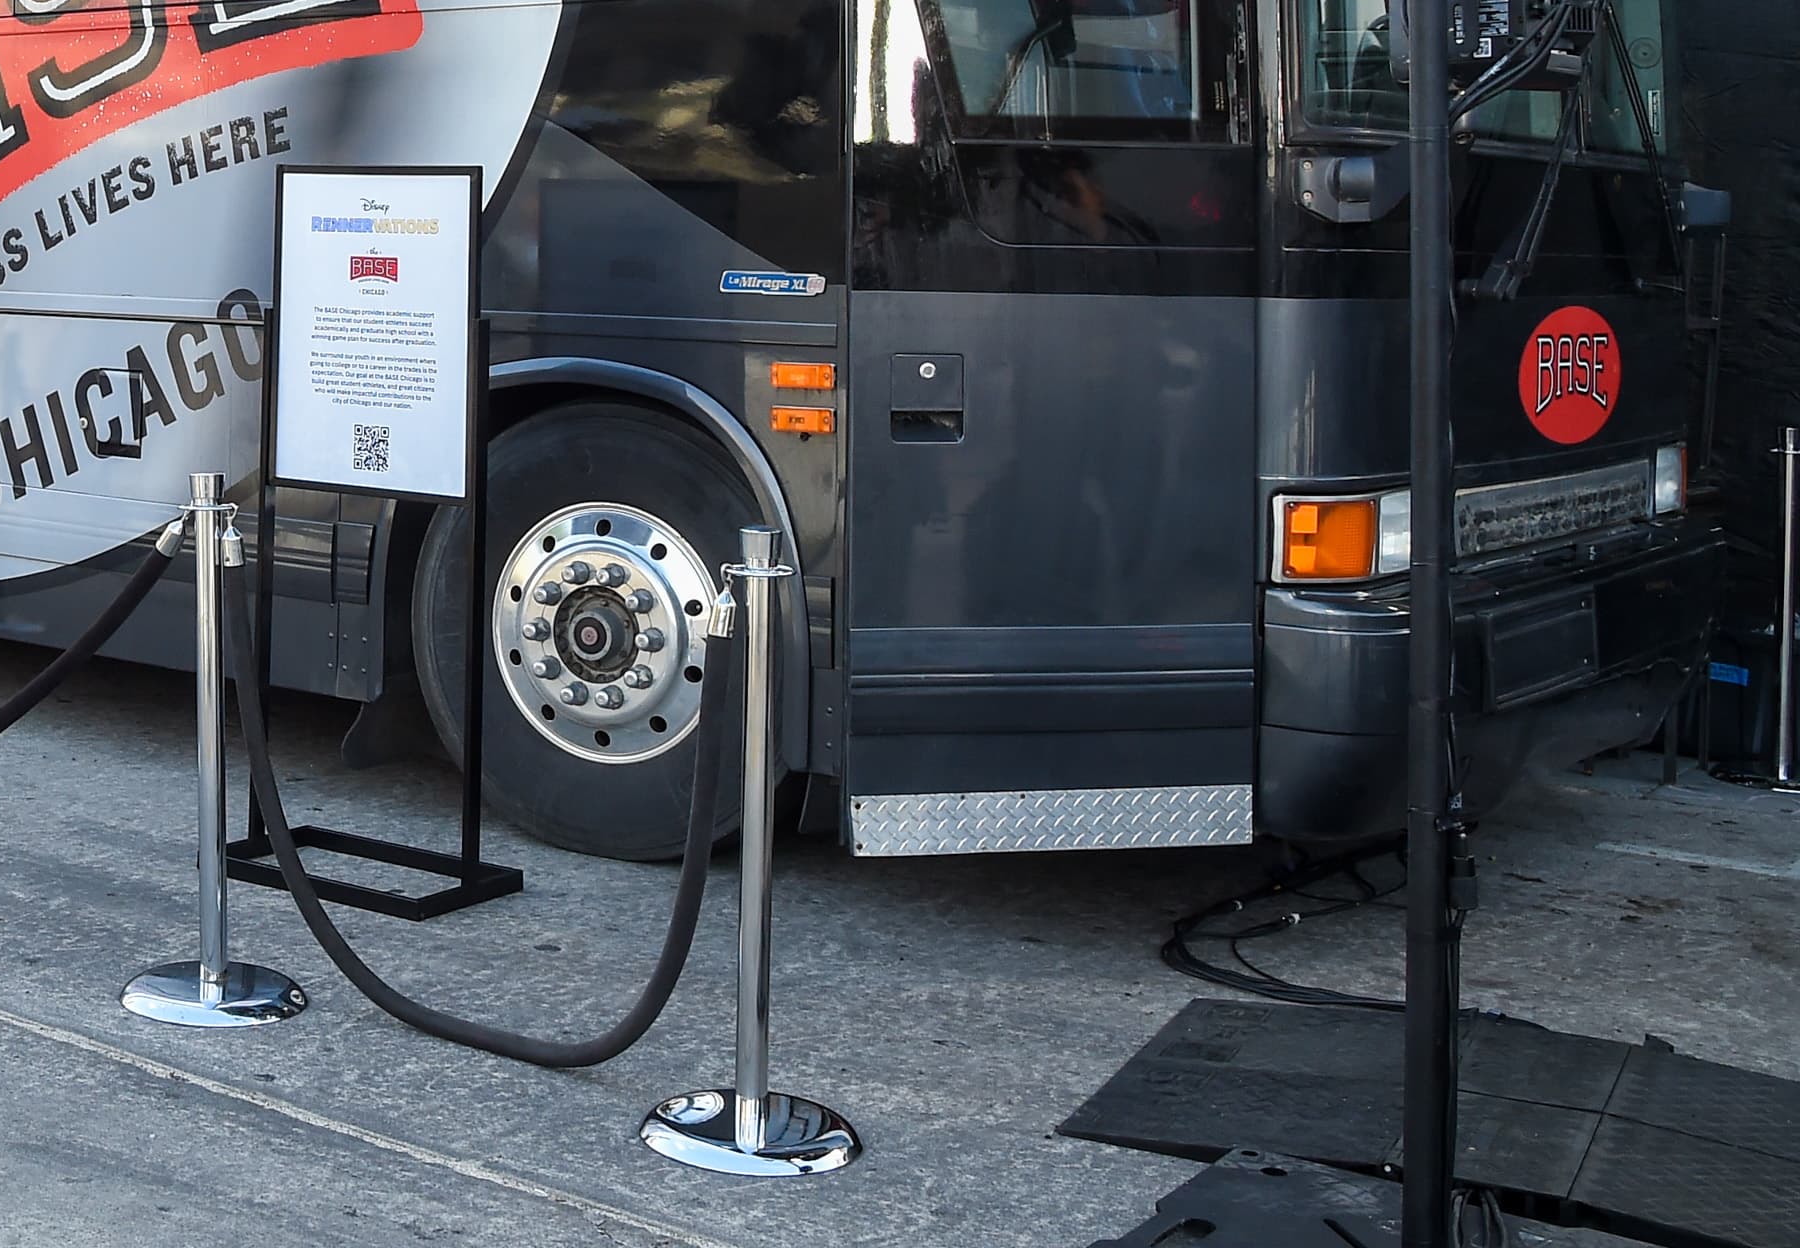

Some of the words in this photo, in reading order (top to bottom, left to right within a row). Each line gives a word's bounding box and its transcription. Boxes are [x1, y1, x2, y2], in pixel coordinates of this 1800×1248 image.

[34, 155, 155, 251] LIVES
[165, 106, 291, 185] HERE
[360, 198, 390, 215] Disney
[352, 258, 396, 279] BASE
[1535, 335, 1608, 414] BASE
